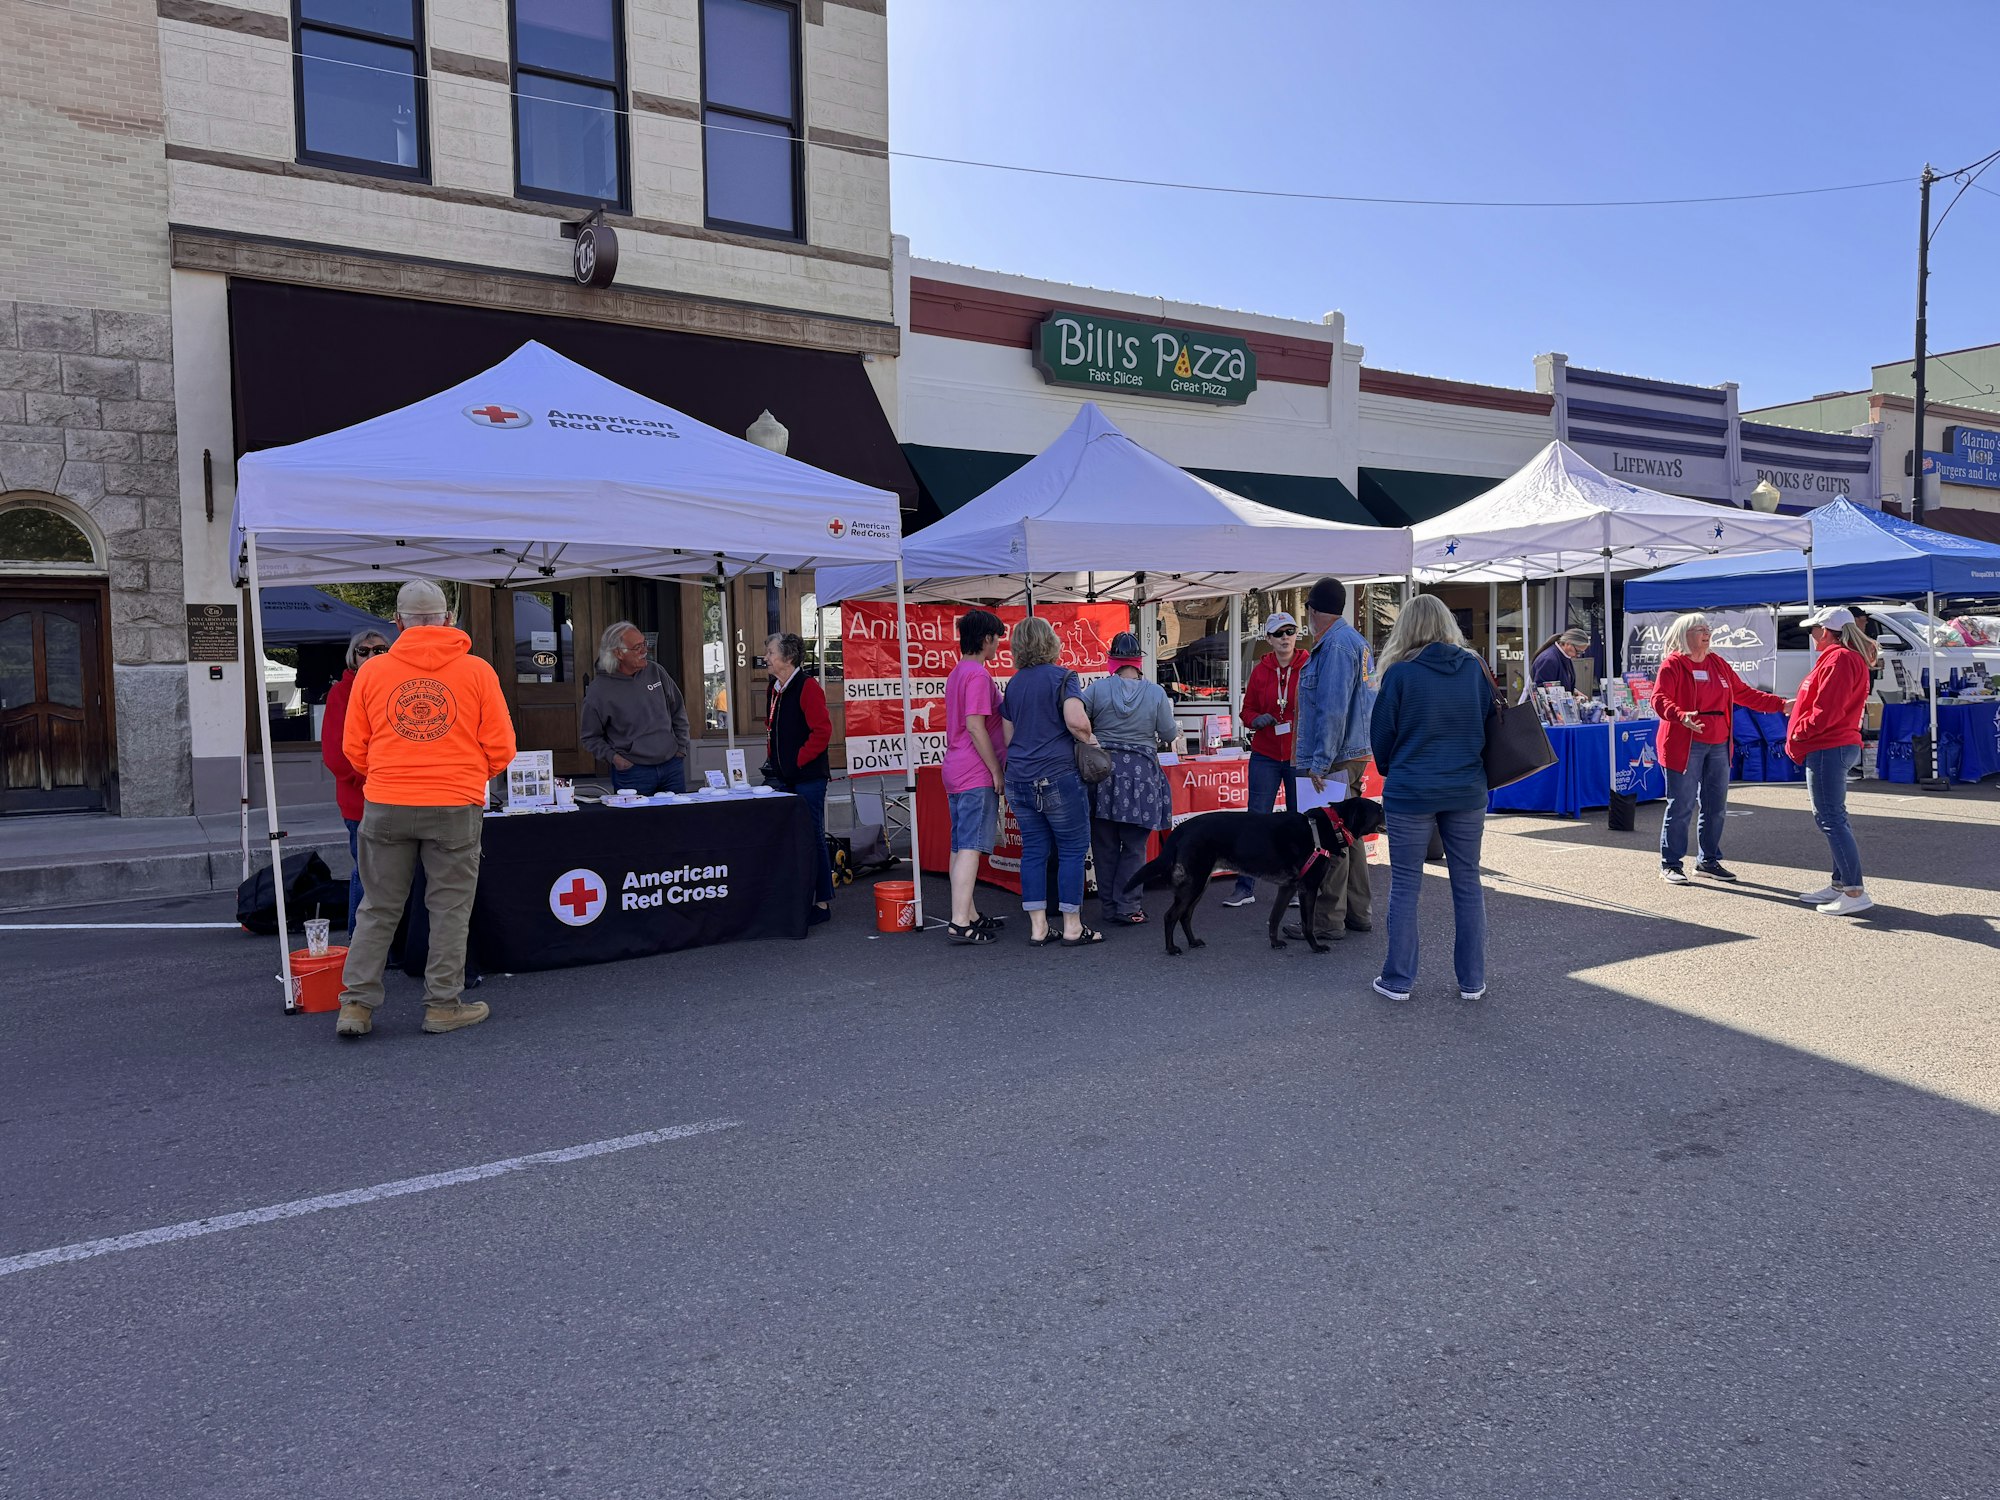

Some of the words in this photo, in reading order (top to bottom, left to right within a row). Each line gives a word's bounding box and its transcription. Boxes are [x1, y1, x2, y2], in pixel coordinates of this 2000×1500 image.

[1055, 319, 1139, 369] Bill's
[1152, 333, 1245, 382] Pizza
[1089, 369, 1112, 383] Fast
[1114, 371, 1143, 386] Slices
[1171, 379, 1199, 393] Great
[1202, 383, 1227, 396] Pizza
[547, 410, 674, 429] American
[548, 419, 601, 431] Red
[606, 424, 680, 439] Cross
[1936, 461, 1966, 480] Burgers
[1968, 467, 1983, 479] and
[1986, 468, 1997, 481] Ice
[1757, 469, 1800, 490] BOOKS
[1803, 473, 1814, 490] &
[1817, 476, 1850, 494] GIFTS
[851, 528, 866, 537] Red
[867, 530, 890, 538] Cross
[852, 520, 890, 530] American
[849, 611, 942, 641] Animal
[736, 628, 747, 667] 105
[535, 654, 554, 665] 'Tis
[400, 680, 417, 693] JEEP
[419, 680, 445, 693] POSSE
[916, 682, 945, 695] FOR
[395, 722, 419, 739] SEARCH
[426, 723, 450, 739] RESCUE
[853, 753, 904, 770] DON'T
[1183, 765, 1245, 789] Animal
[622, 864, 728, 890] American
[622, 889, 663, 911] Red
[666, 884, 728, 904] Cross
